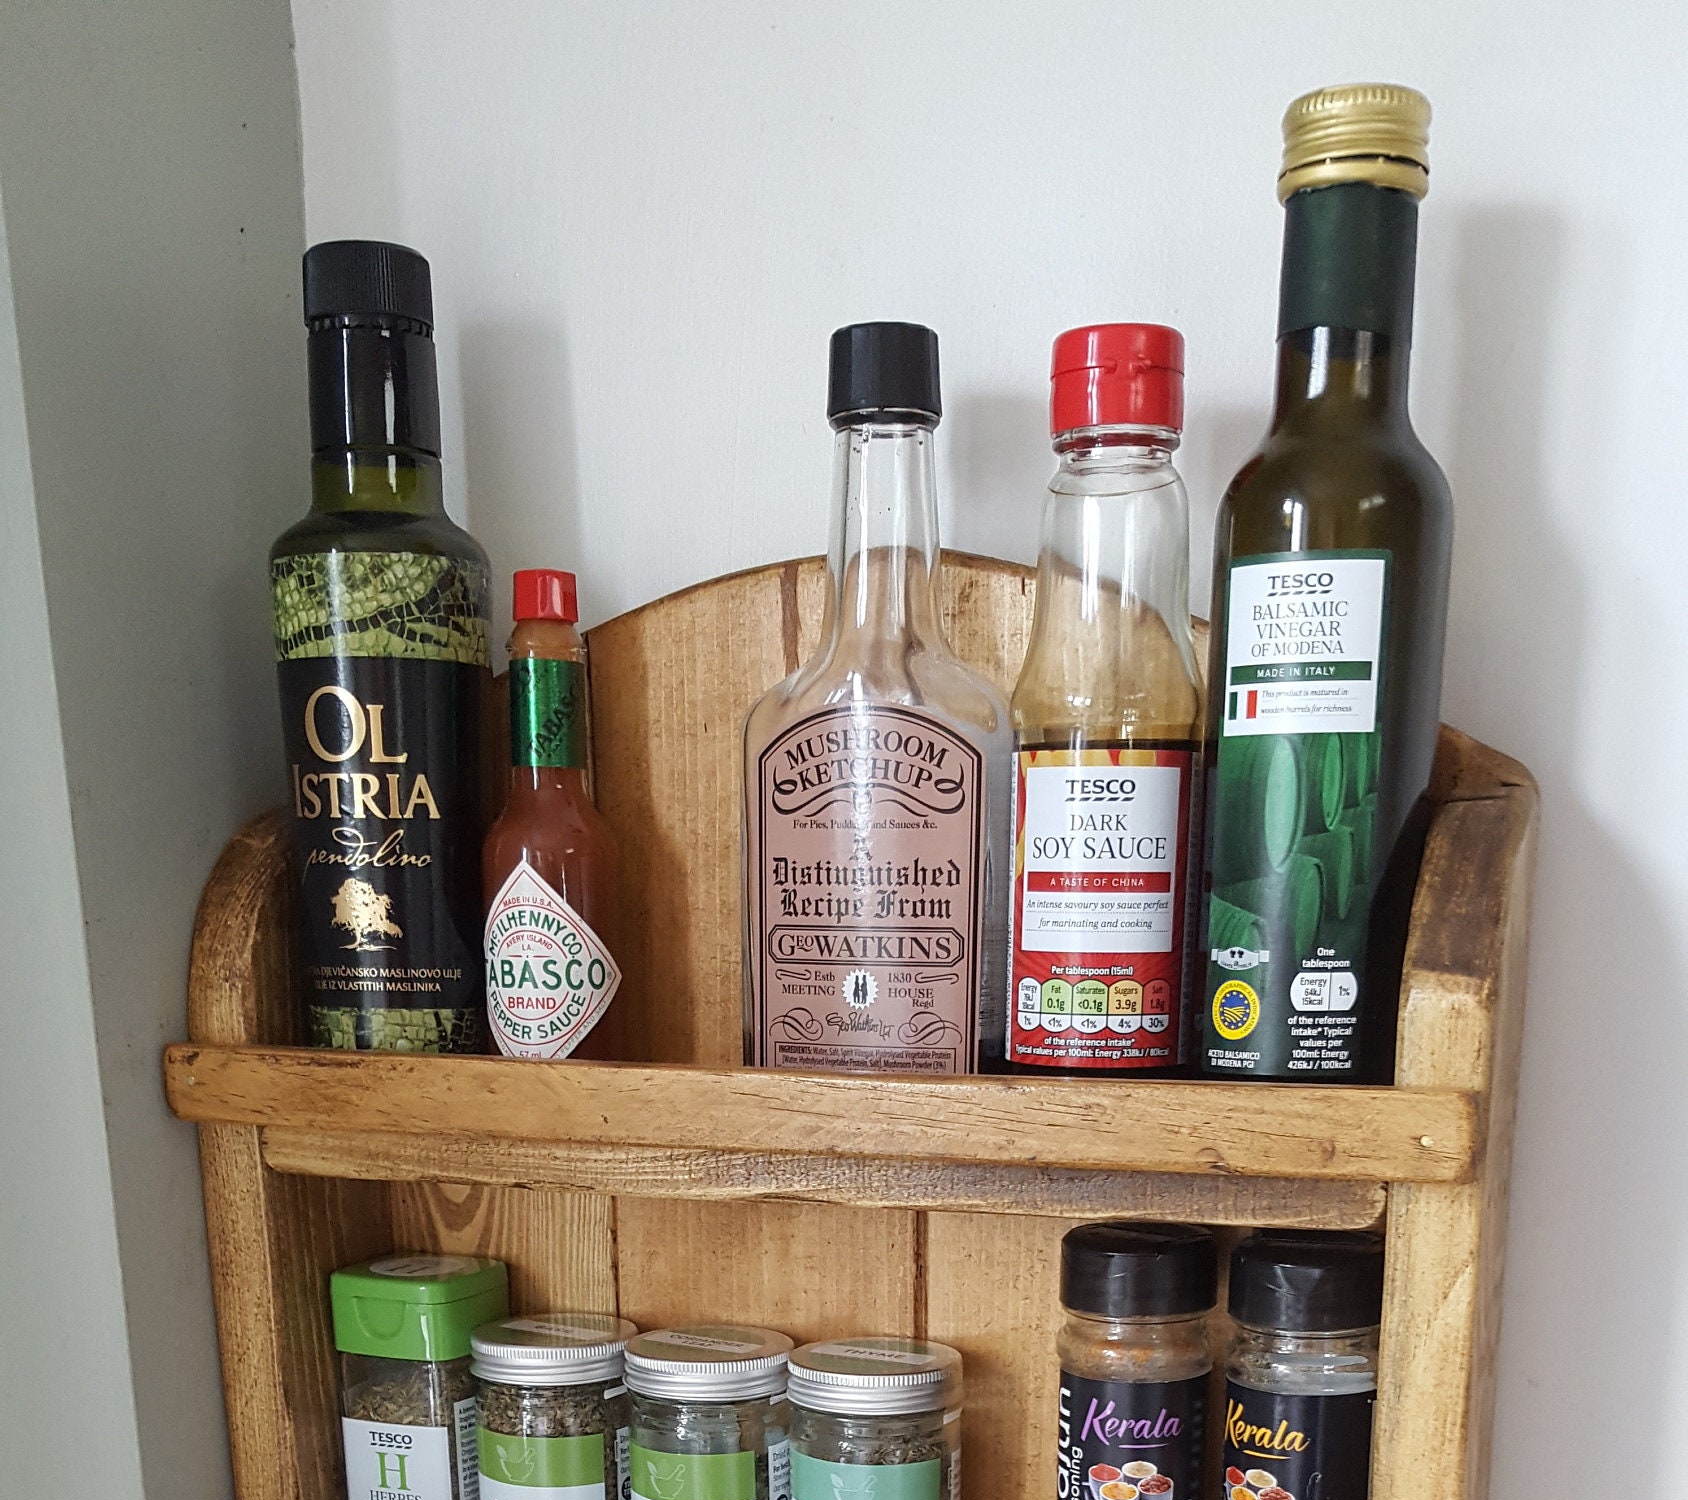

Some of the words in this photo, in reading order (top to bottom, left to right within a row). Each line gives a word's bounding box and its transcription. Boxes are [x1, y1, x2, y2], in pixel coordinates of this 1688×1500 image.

[1268, 573, 1334, 589] TESCO
[1253, 601, 1348, 621] BALSAMIC
[1257, 621, 1341, 639] VINEGAR
[1251, 643, 1270, 657] OF
[1273, 640, 1345, 656] MODENA
[1257, 668, 1284, 677] MADE
[1289, 667, 1300, 676] IN
[1305, 666, 1336, 676] ITALY
[305, 686, 408, 764] OL
[784, 729, 949, 770] MUSHROOM
[797, 758, 933, 792] KETCHUP
[293, 764, 440, 820] ISTRIA
[1065, 779, 1135, 795] TESCO
[793, 820, 808, 829] For
[889, 820, 920, 829] Sauces
[1070, 814, 1127, 832] DARK
[1032, 837, 1076, 860] SOY
[1083, 837, 1167, 860] SAUCE
[1050, 878, 1057, 887] A
[1060, 878, 1089, 887] TASTE
[1093, 878, 1109, 887] OF
[1111, 878, 1144, 887] CHINA
[503, 896, 521, 908] MADE
[781, 888, 864, 924] Recipe
[873, 889, 952, 919] From
[1037, 900, 1062, 910] intense
[1064, 901, 1098, 912] savoury
[1100, 902, 1115, 913] soy
[1117, 902, 1141, 910] sauce
[1143, 900, 1168, 913] perfect
[1038, 918, 1050, 929] for
[1052, 918, 1100, 930] marinating
[1102, 918, 1118, 929] and
[1121, 918, 1152, 930] cooking
[506, 934, 524, 949] AVERY
[527, 934, 553, 951] ISLAND
[1317, 948, 1335, 956] One
[1302, 959, 1350, 969] tablespoon
[380, 969, 440, 978] MASLINOVO
[485, 958, 606, 990] ABASCO
[888, 972, 912, 983] 1830
[1052, 966, 1064, 974] Per
[1066, 966, 1109, 977] tablespoon
[338, 981, 384, 991] VLASTITIH
[386, 982, 441, 992] MASLINIKA
[1300, 977, 1327, 987] Energy
[782, 984, 836, 997] MEETING
[888, 987, 934, 999] HOUSE
[1051, 986, 1061, 994] Fat
[1076, 986, 1105, 994] Saturates
[1114, 987, 1138, 996] Sugars
[507, 997, 556, 1010] BRAND
[1047, 998, 1064, 1011] 0.1g
[1078, 1000, 1103, 1012] <0.1g
[1115, 1000, 1136, 1012] 3.9g
[490, 991, 532, 1039] PEPPER
[537, 993, 586, 1039] SAUCE
[1315, 1016, 1357, 1024] reference
[1118, 1018, 1131, 1028] 4%
[1324, 1027, 1352, 1037] Typical
[1053, 1037, 1065, 1045] the
[1066, 1037, 1106, 1046] reference
[1300, 1039, 1326, 1048] values
[1328, 1040, 1343, 1049] per
[1095, 1048, 1120, 1059] Energy
[1322, 1050, 1348, 1060] Energy
[1081, 1397, 1183, 1446] Kerala
[1224, 1398, 1311, 1452] Kerala
[369, 1431, 412, 1445] TESCO
[376, 1451, 411, 1491] H
